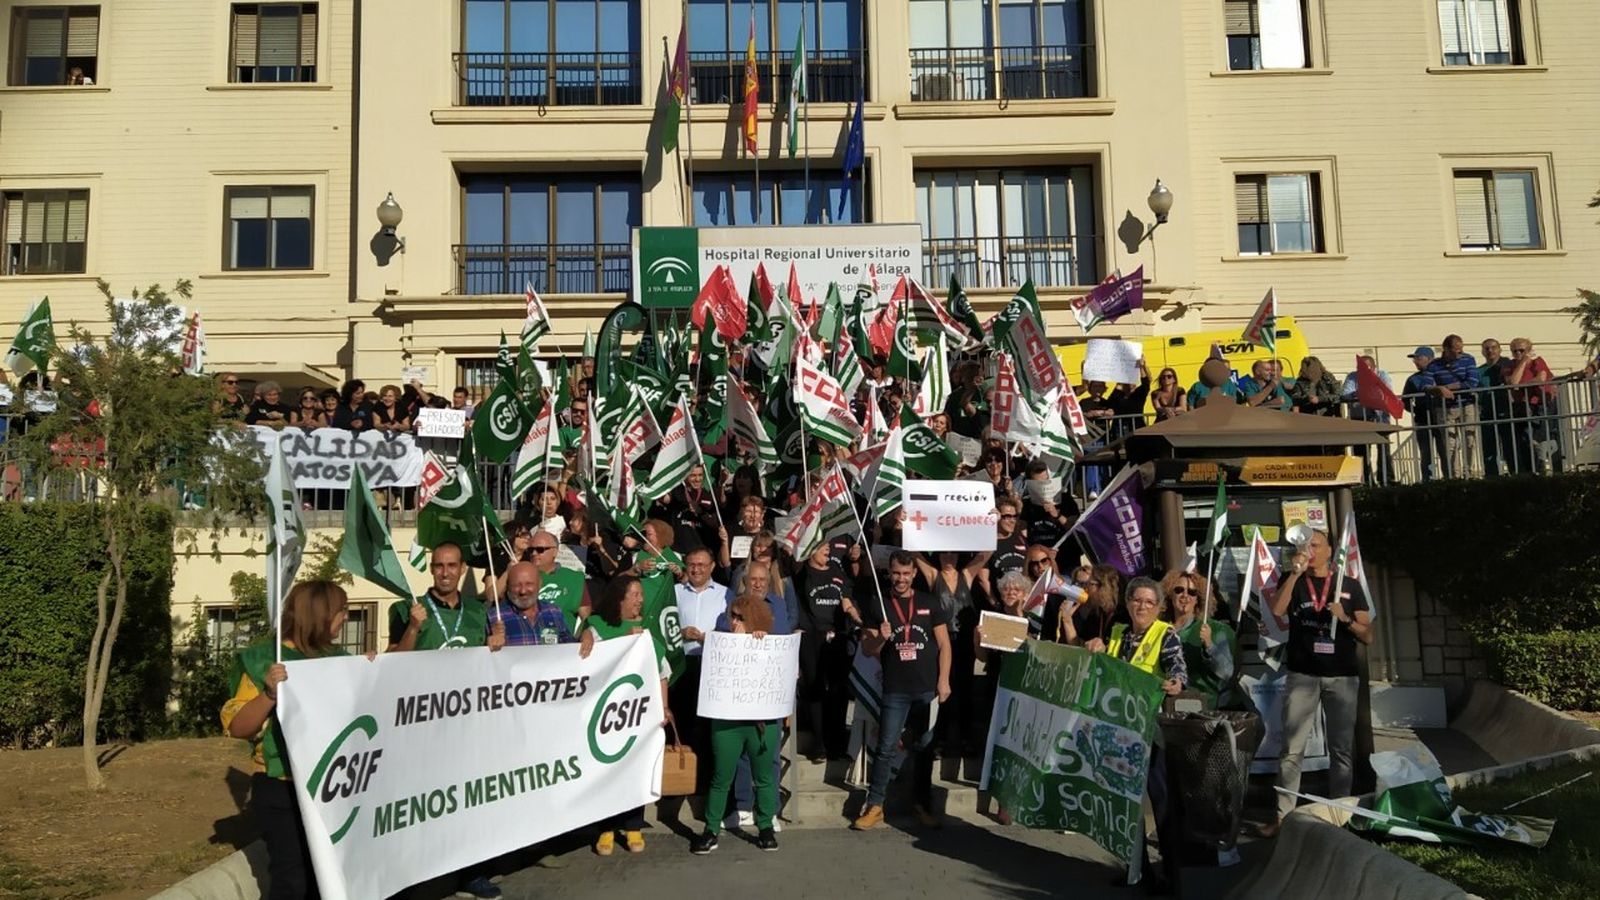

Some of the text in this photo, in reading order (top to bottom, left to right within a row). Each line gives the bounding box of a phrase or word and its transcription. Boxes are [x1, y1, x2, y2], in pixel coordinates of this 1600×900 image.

[704, 247, 911, 262] Hospital Regional Universitario
[842, 263, 911, 277] de álaga
[496, 398, 519, 430] CSIF
[280, 433, 407, 460] CALIDAD
[905, 430, 945, 453] CSIF
[361, 461, 399, 486] YA
[1264, 463, 1287, 471] CADA
[1252, 471, 1337, 480] BOTES MILLONARIOS
[1308, 509, 1324, 521] 39
[538, 588, 562, 600] CSIF
[666, 615, 684, 650] CSIF
[711, 634, 737, 649] NOS
[710, 651, 760, 666] ANULAR
[764, 666, 785, 678] SIN
[706, 678, 785, 690] CELADORES
[394, 674, 590, 727] MENOS RECORTES
[707, 688, 793, 705] AL HOSPITAL
[599, 695, 650, 735] CSIF
[320, 748, 383, 803] CSIF
[372, 755, 582, 838] MENOS MENTIRAS
